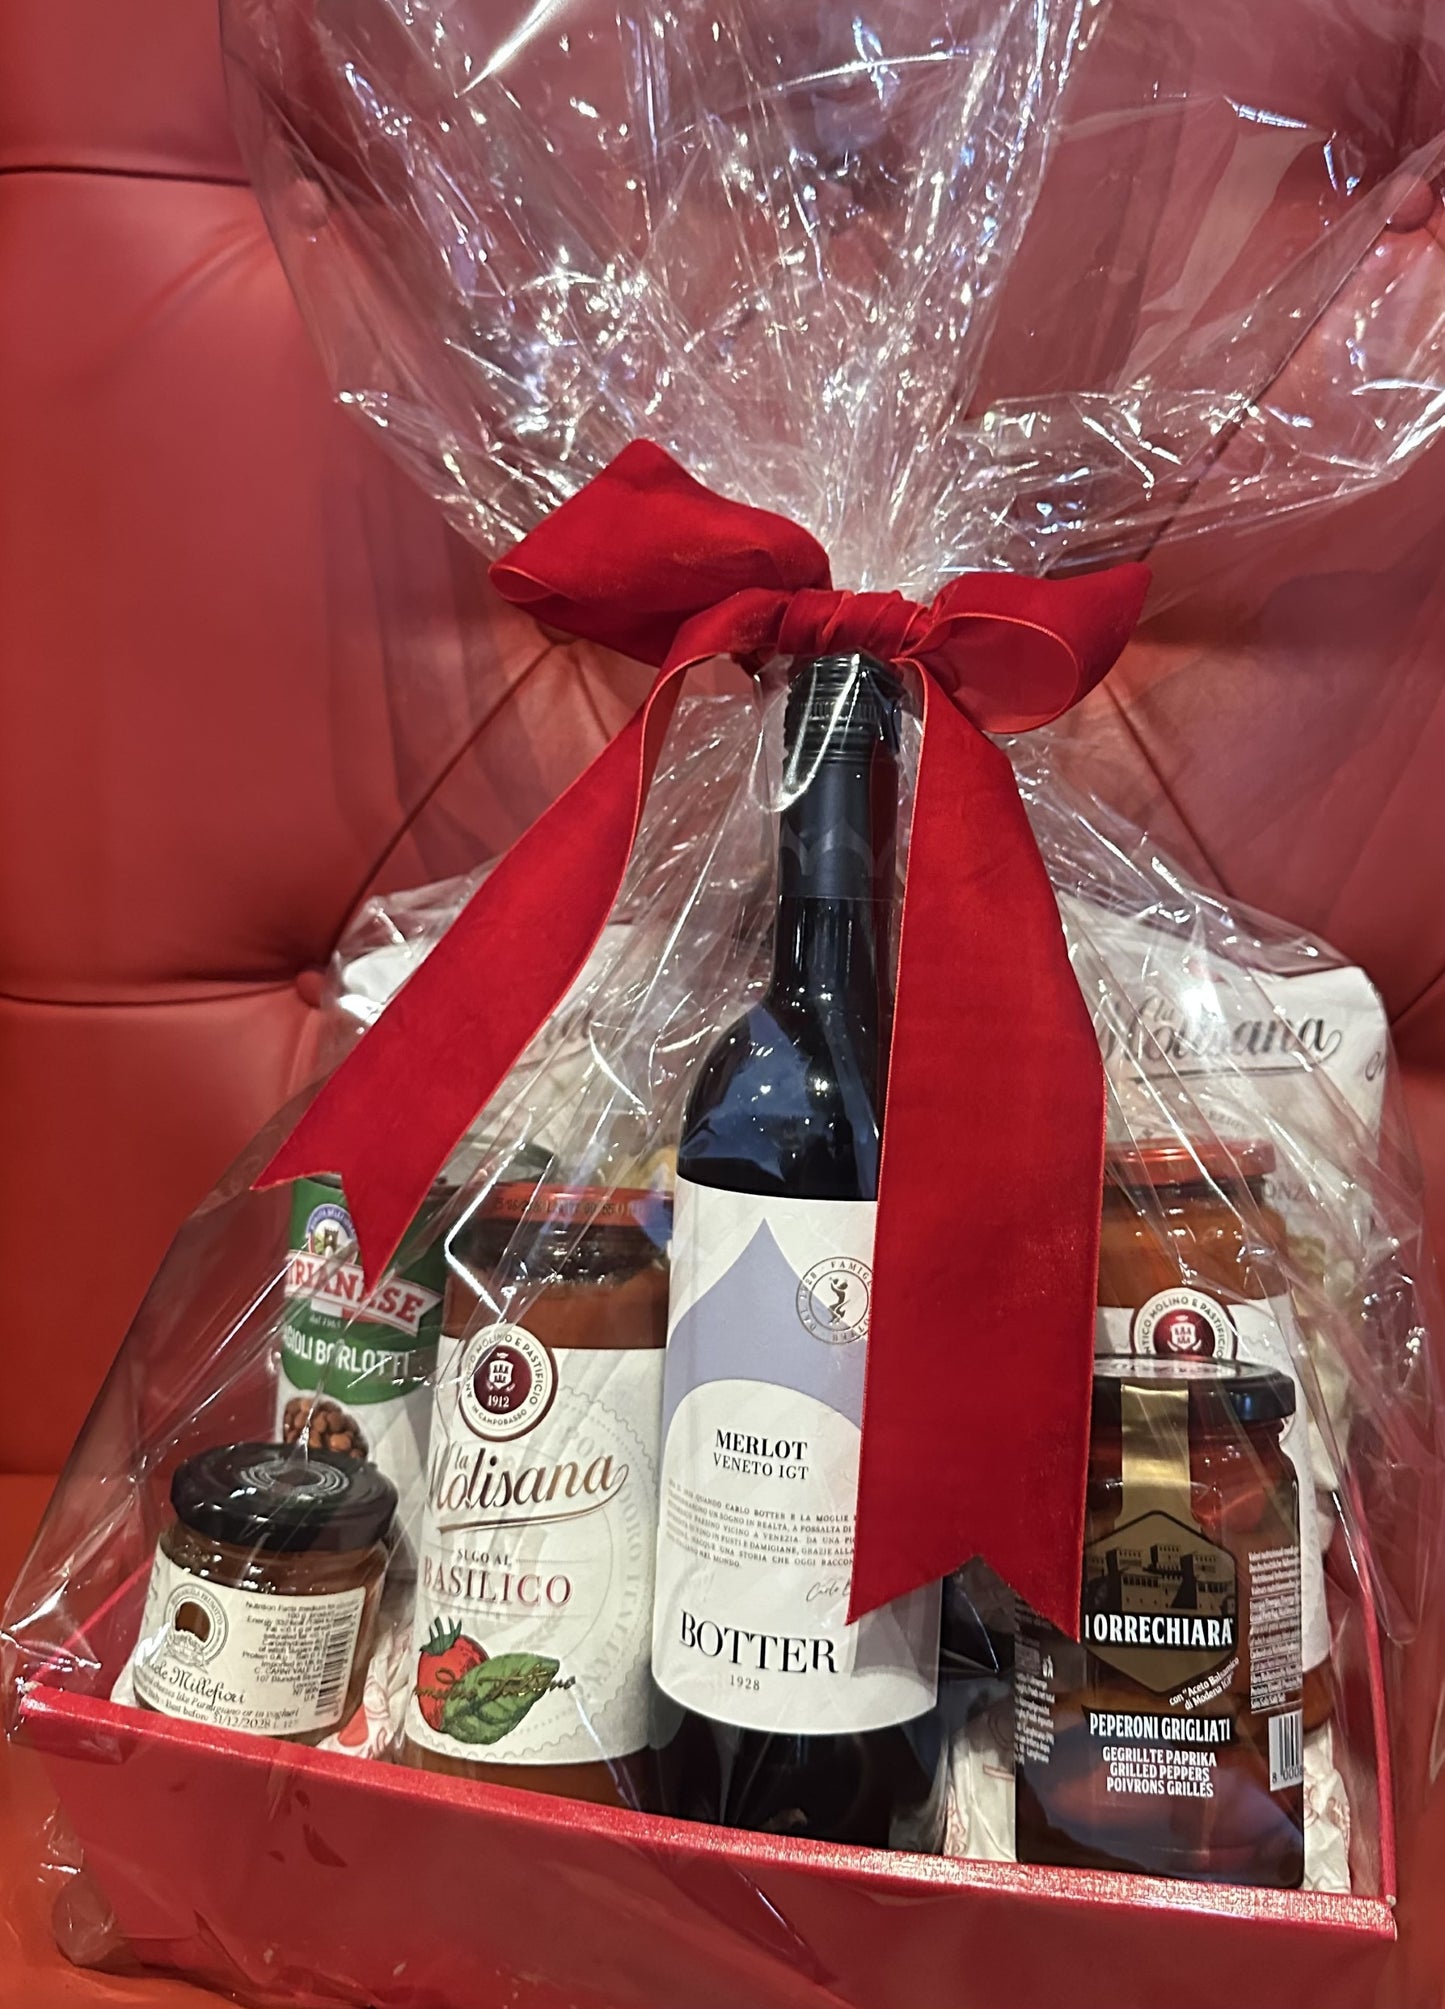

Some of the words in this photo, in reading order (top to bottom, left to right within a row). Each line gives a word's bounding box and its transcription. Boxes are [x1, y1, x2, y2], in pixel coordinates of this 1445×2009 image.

[1103, 998, 1342, 1062] Molana
[1142, 1320, 1152, 1354] NTICO
[1151, 1296, 1189, 1318] MOLINO
[1192, 1299, 1198, 1307] E
[1200, 1303, 1226, 1358] PASTIFICIO
[476, 1334, 512, 1353] MOLINO
[515, 1338, 522, 1346] E
[523, 1344, 543, 1405] PASTIFICIO
[487, 1394, 510, 1407] 1912
[472, 1405, 479, 1413] IN
[479, 1408, 527, 1425] CAMPOBASSO
[715, 1428, 808, 1460] MERLOT
[455, 1446, 469, 1470] la
[713, 1452, 773, 1476] VENETO
[779, 1464, 809, 1480] IGT
[696, 1493, 721, 1509] QUANDO
[725, 1503, 750, 1515] CARLO
[754, 1508, 785, 1521] BOTTER
[801, 1514, 811, 1522] LA
[816, 1514, 849, 1522] MOGLIE
[720, 1512, 744, 1524] SOGNO
[746, 1519, 754, 1527] IN
[801, 1525, 840, 1533] FOSSALTA
[721, 1535, 741, 1546] FUSTI
[801, 1547, 832, 1555] GRAZIE
[834, 1547, 855, 1555] ALLA
[723, 1525, 749, 1536] VICINO
[806, 1536, 817, 1544] DA
[457, 1548, 489, 1563] SUGO
[494, 1554, 512, 1567] AL
[720, 1546, 734, 1556] UNA
[739, 1550, 767, 1562] STORIA
[772, 1555, 789, 1564] CHE
[424, 1555, 572, 1608] BASILICO
[679, 1608, 839, 1673] BOTTER
[170, 1666, 246, 1707] Millefiori
[730, 1674, 760, 1691] 1928
[1169, 1693, 1184, 1706] con
[1208, 1657, 1240, 1686] Balsamico
[191, 1697, 240, 1718] Parmigiano
[1185, 1699, 1194, 1711] di
[1192, 1685, 1222, 1706] Modena
[212, 1713, 270, 1729] 31/12/2028
[1090, 1712, 1159, 1739] PEPERONI
[1161, 1717, 1230, 1742] GRIGLIATI
[1102, 1746, 1164, 1763] GEGRILLTE
[1165, 1749, 1217, 1767] PAPRIKA
[1110, 1762, 1157, 1778] GRILLED
[1159, 1765, 1210, 1782] PEPPERS
[1272, 1772, 1277, 1784] 8
[1107, 1777, 1165, 1795] POIVRONS
